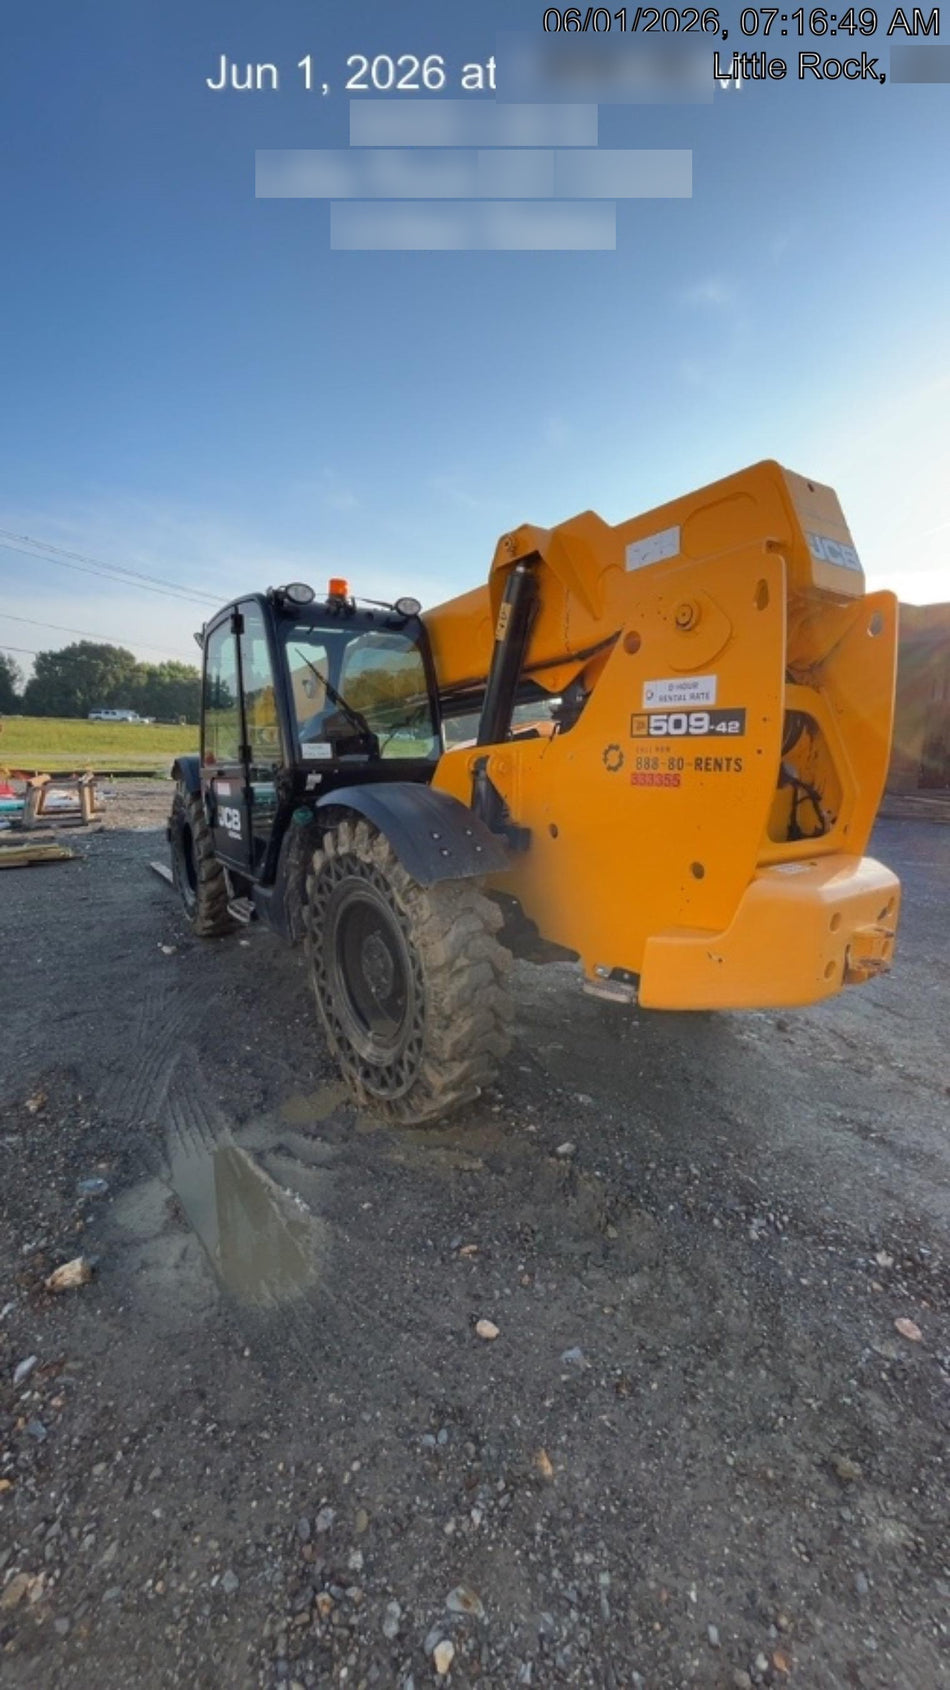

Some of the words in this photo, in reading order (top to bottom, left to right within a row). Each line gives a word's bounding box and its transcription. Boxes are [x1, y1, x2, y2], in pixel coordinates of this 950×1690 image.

[810, 535, 861, 571] JCB
[649, 712, 740, 735] 509-42
[217, 805, 241, 831] JCB
